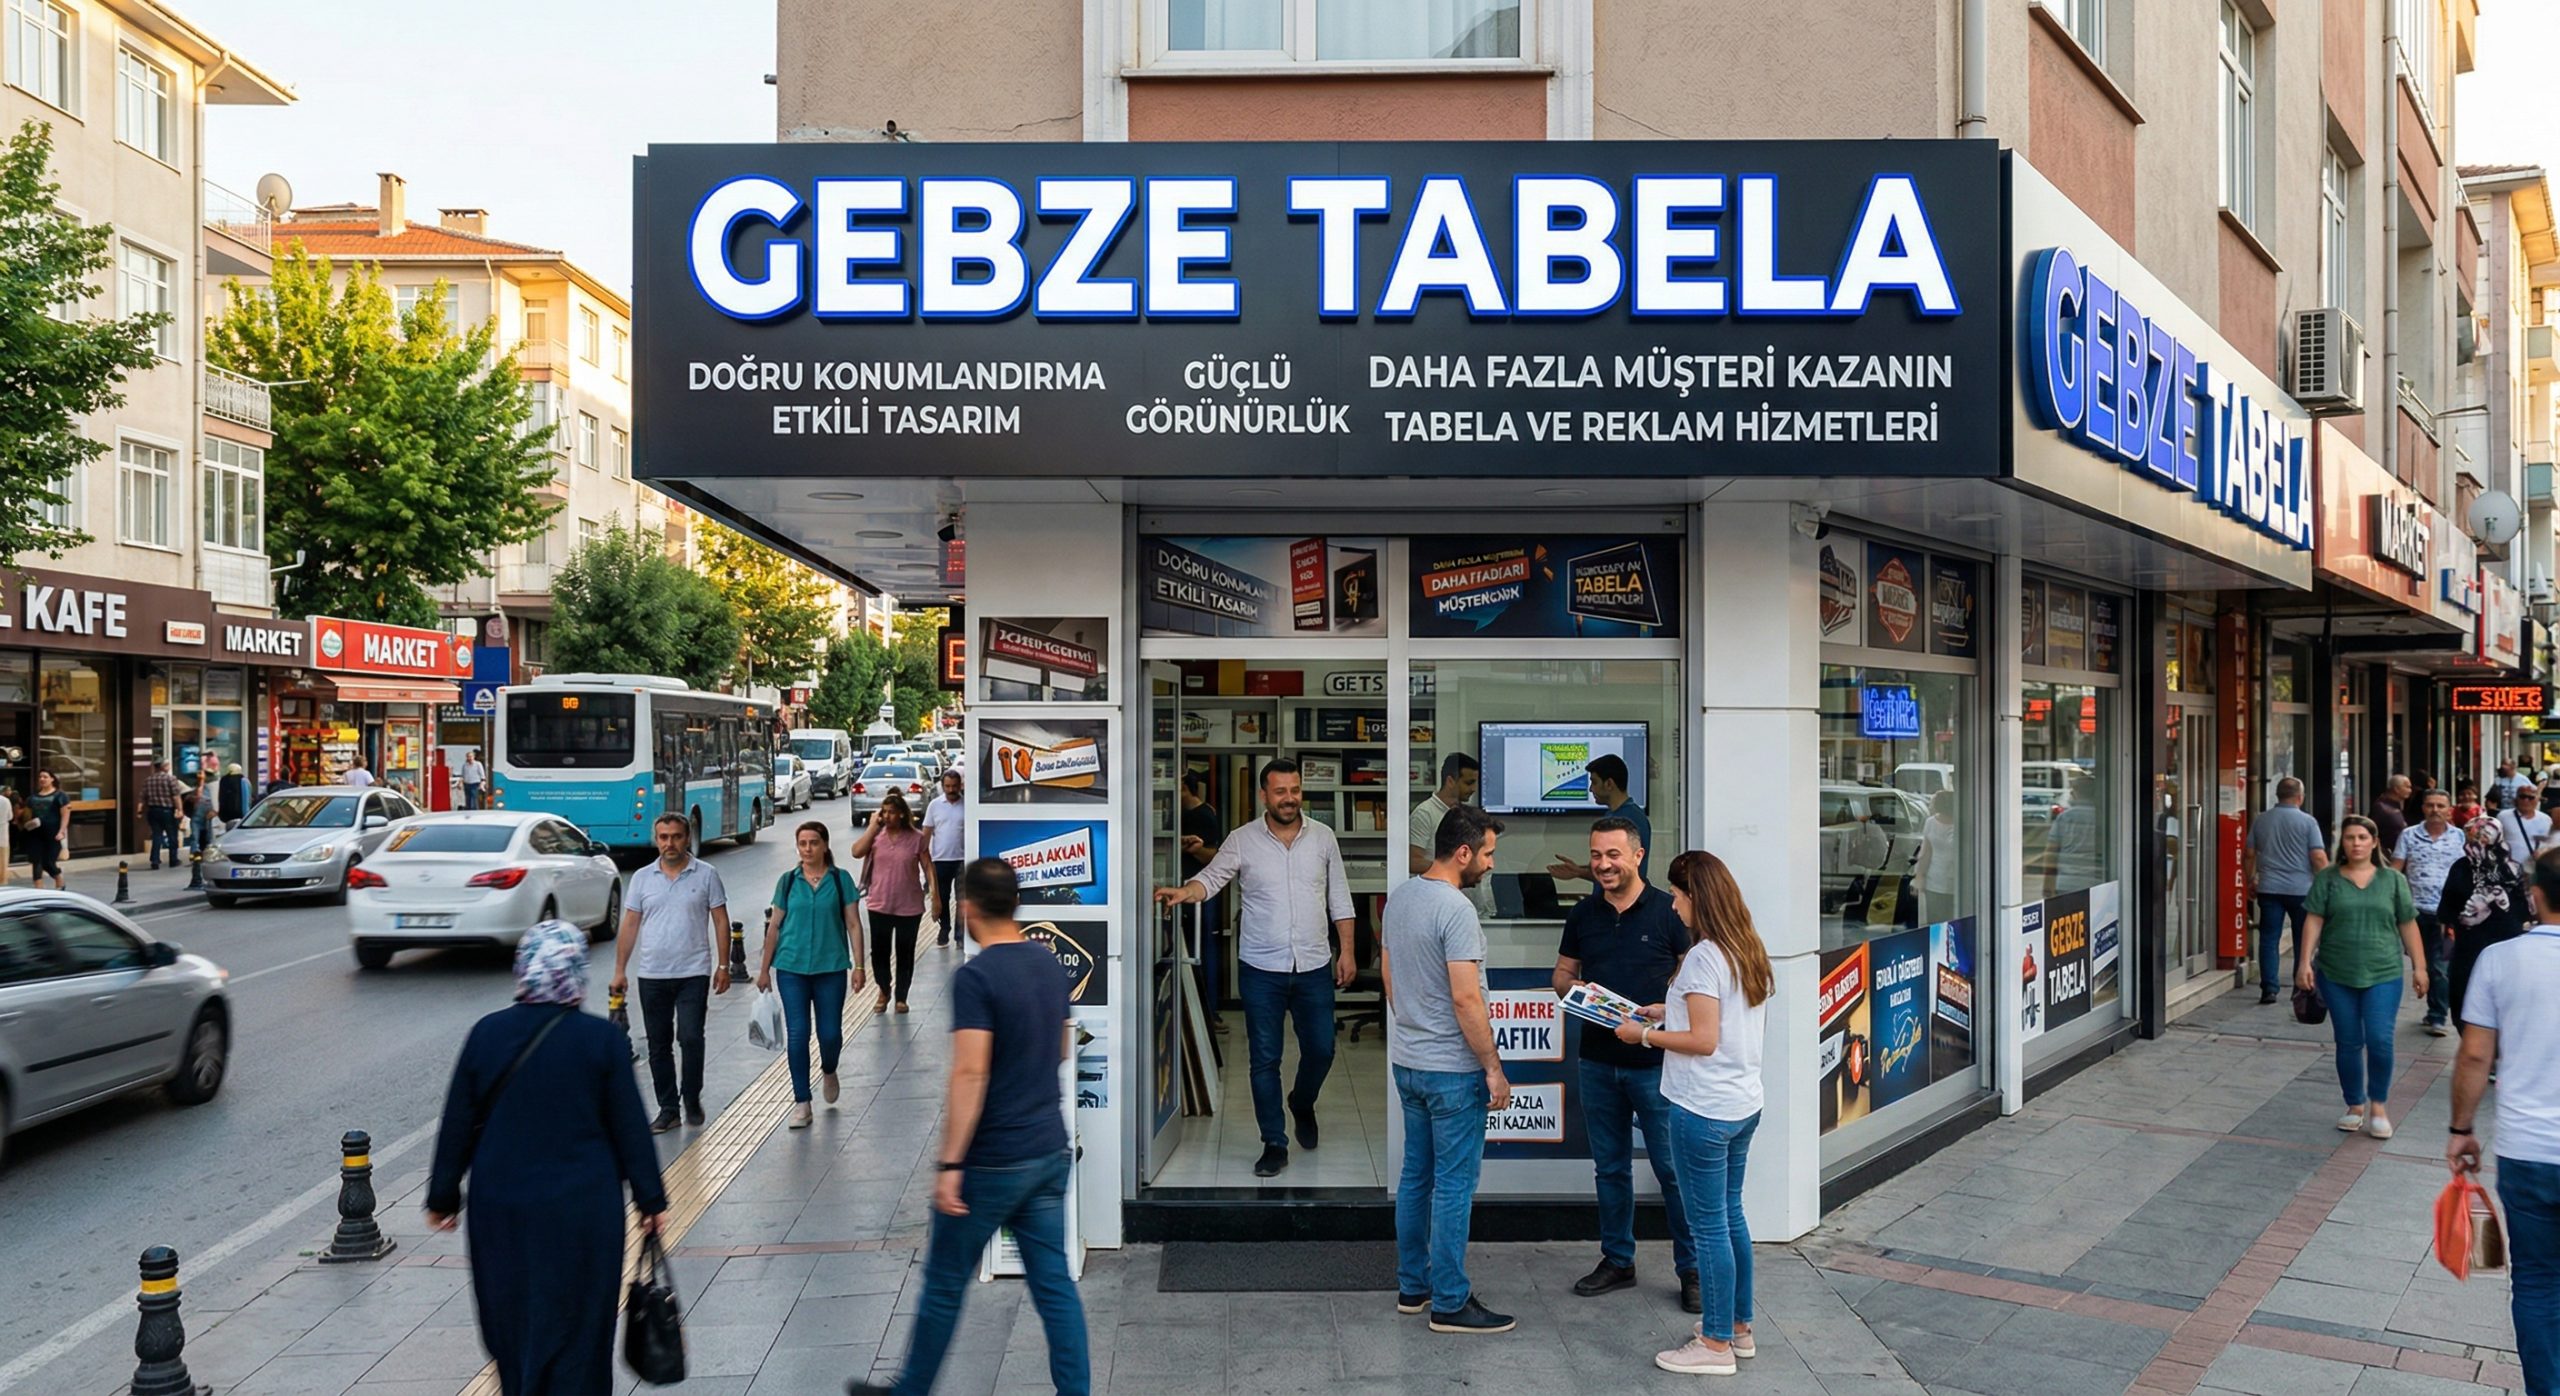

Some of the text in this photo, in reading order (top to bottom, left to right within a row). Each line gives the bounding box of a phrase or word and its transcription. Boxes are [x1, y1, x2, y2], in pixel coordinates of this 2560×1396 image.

[687, 172, 1964, 322] GEBZE TABELA
[688, 354, 1106, 390] DOĞRU KONUMLANDIRMA
[1183, 353, 1291, 397] GÜÇLÜ
[1369, 345, 1953, 397] DAHA FAZLA MÜŞTERİ KAZANIN
[772, 396, 1021, 434] ETKİLİ TASARIM
[1126, 398, 1350, 434] GÖRÜNÜRLÜK
[2032, 246, 2314, 551] GEBZE TABELA
[1385, 402, 1939, 442] TABELA VE REKLAM HİZMETLERİ
[2374, 496, 2430, 581] MARKET
[1158, 549, 1209, 581] DOĞRU
[1432, 573, 1468, 591] DAHA
[1575, 572, 1643, 594] TABELA
[26, 584, 127, 638] KAFE
[1157, 577, 1259, 619] ETKİLİ TASARIM
[225, 624, 303, 656] MARKET
[363, 632, 439, 668] MARKET
[2050, 910, 2086, 958] GEBZE
[2048, 958, 2087, 1006] TABELA
[1513, 1002, 1555, 1019] MERE
[1509, 1095, 1544, 1110] FAZLA
[1503, 1115, 1556, 1130] KAZANIN
